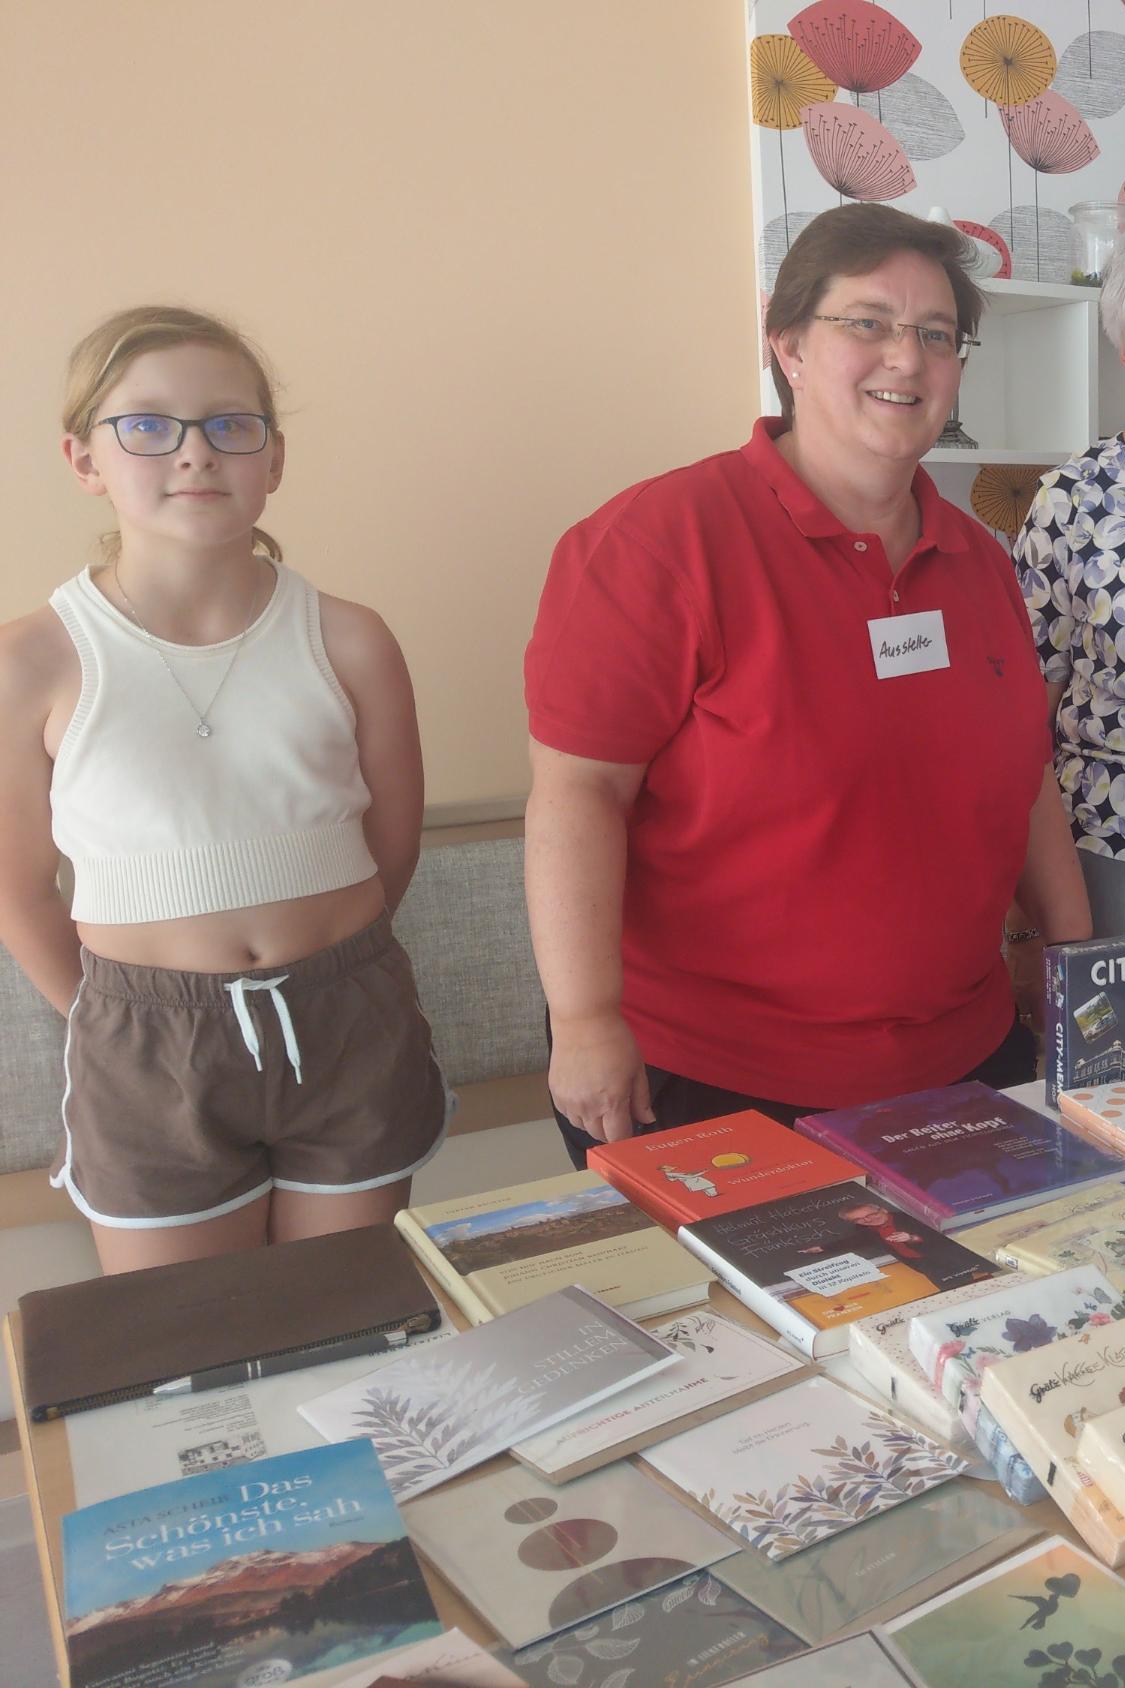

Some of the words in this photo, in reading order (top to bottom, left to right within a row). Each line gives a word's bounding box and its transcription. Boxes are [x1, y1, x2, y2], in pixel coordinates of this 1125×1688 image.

[1054, 1022, 1065, 1094] CITY-MEM
[645, 1135, 695, 1152] Eugen
[696, 1126, 734, 1140] Roth
[881, 1131, 908, 1143] Der
[909, 1120, 958, 1138] Reiter
[930, 1129, 963, 1141] ohne
[962, 1115, 1008, 1134] Kopf
[578, 1320, 604, 1336] IN
[517, 1339, 628, 1395] GEDENKEN
[533, 1329, 617, 1370] STILLEM
[555, 1409, 633, 1447] AUFRICHTIGE
[633, 1377, 710, 1412] ANTEILNAHME
[239, 1474, 313, 1503] Das
[130, 1538, 212, 1571] was
[222, 1518, 283, 1547] ich
[293, 1497, 362, 1528] sah
